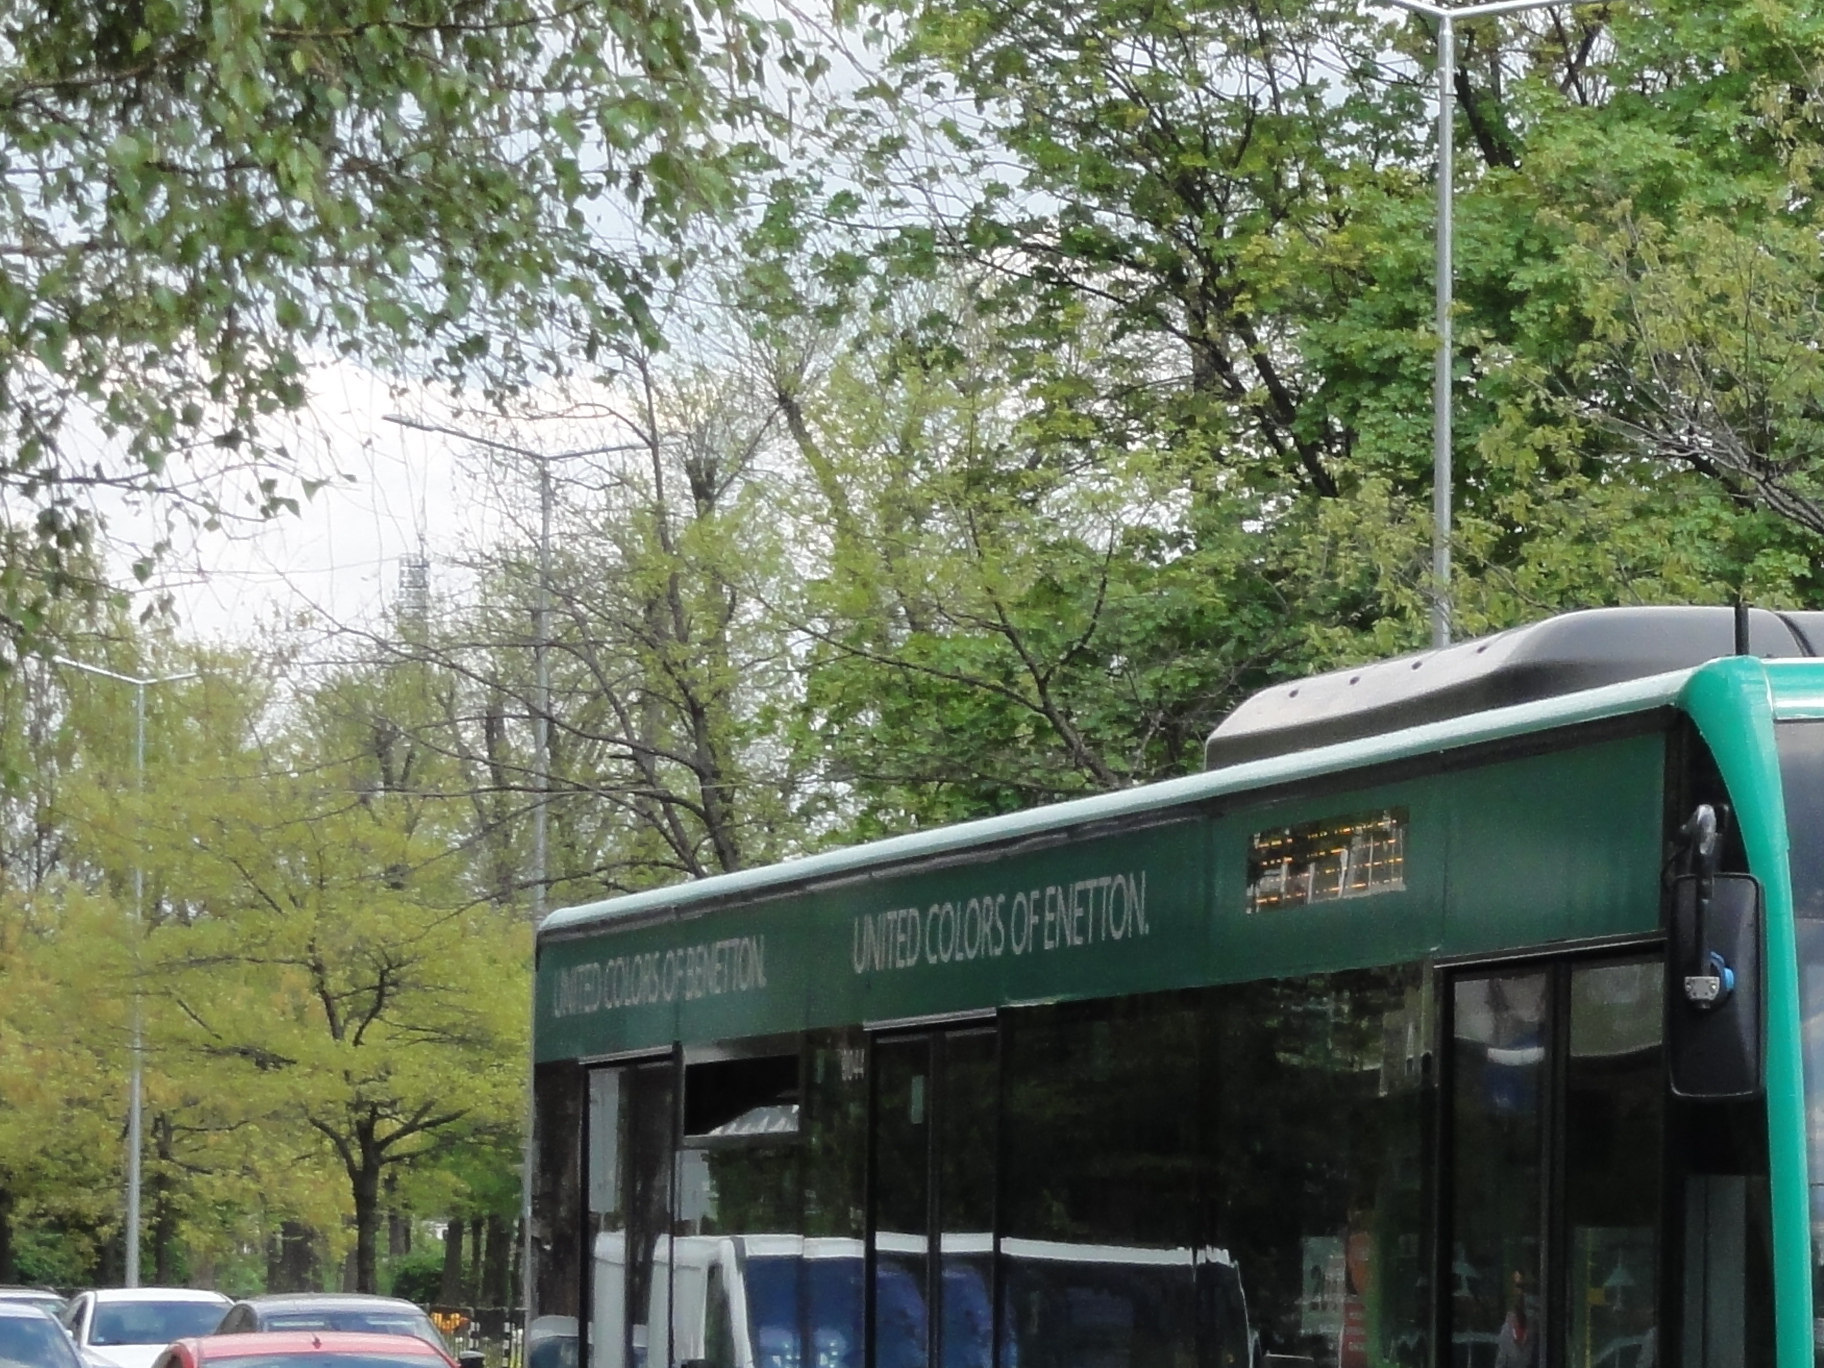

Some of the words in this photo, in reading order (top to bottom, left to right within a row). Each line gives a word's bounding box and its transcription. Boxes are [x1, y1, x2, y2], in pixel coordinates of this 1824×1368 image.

[853, 908, 920, 974] UNITED
[925, 894, 1005, 964] COLORS
[1011, 890, 1040, 953] OF
[1044, 870, 1149, 950] ENETTON.
[554, 963, 600, 1018] UNITED
[604, 952, 659, 1009] COLORS
[663, 949, 684, 1001] OF
